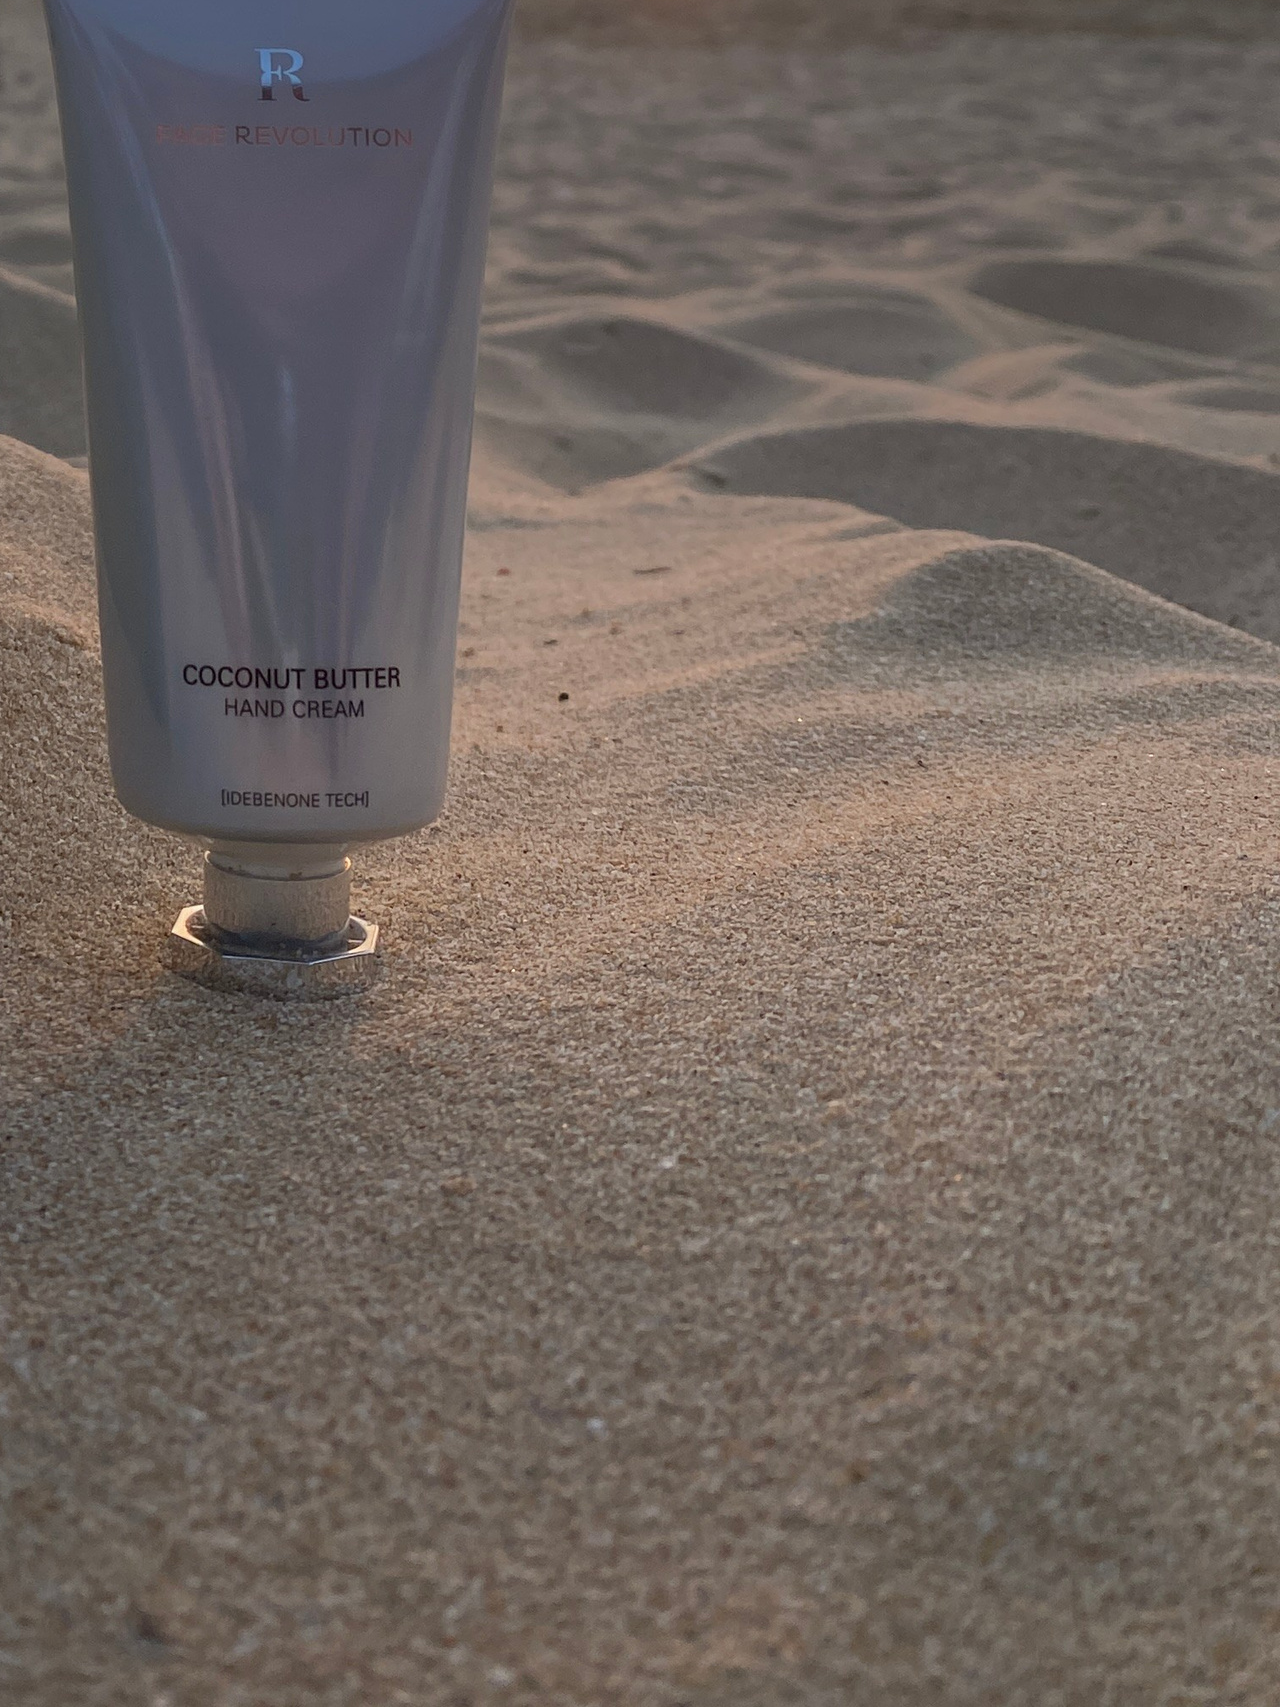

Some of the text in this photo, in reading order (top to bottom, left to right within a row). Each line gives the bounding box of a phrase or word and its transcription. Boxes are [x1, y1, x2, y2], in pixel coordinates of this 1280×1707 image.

[235, 125, 413, 147] REVOLUTION
[183, 664, 401, 690] COCONUT BUTTER
[224, 697, 365, 719] HAND CREAM
[221, 788, 369, 808] [IDEBENONE TECH]
